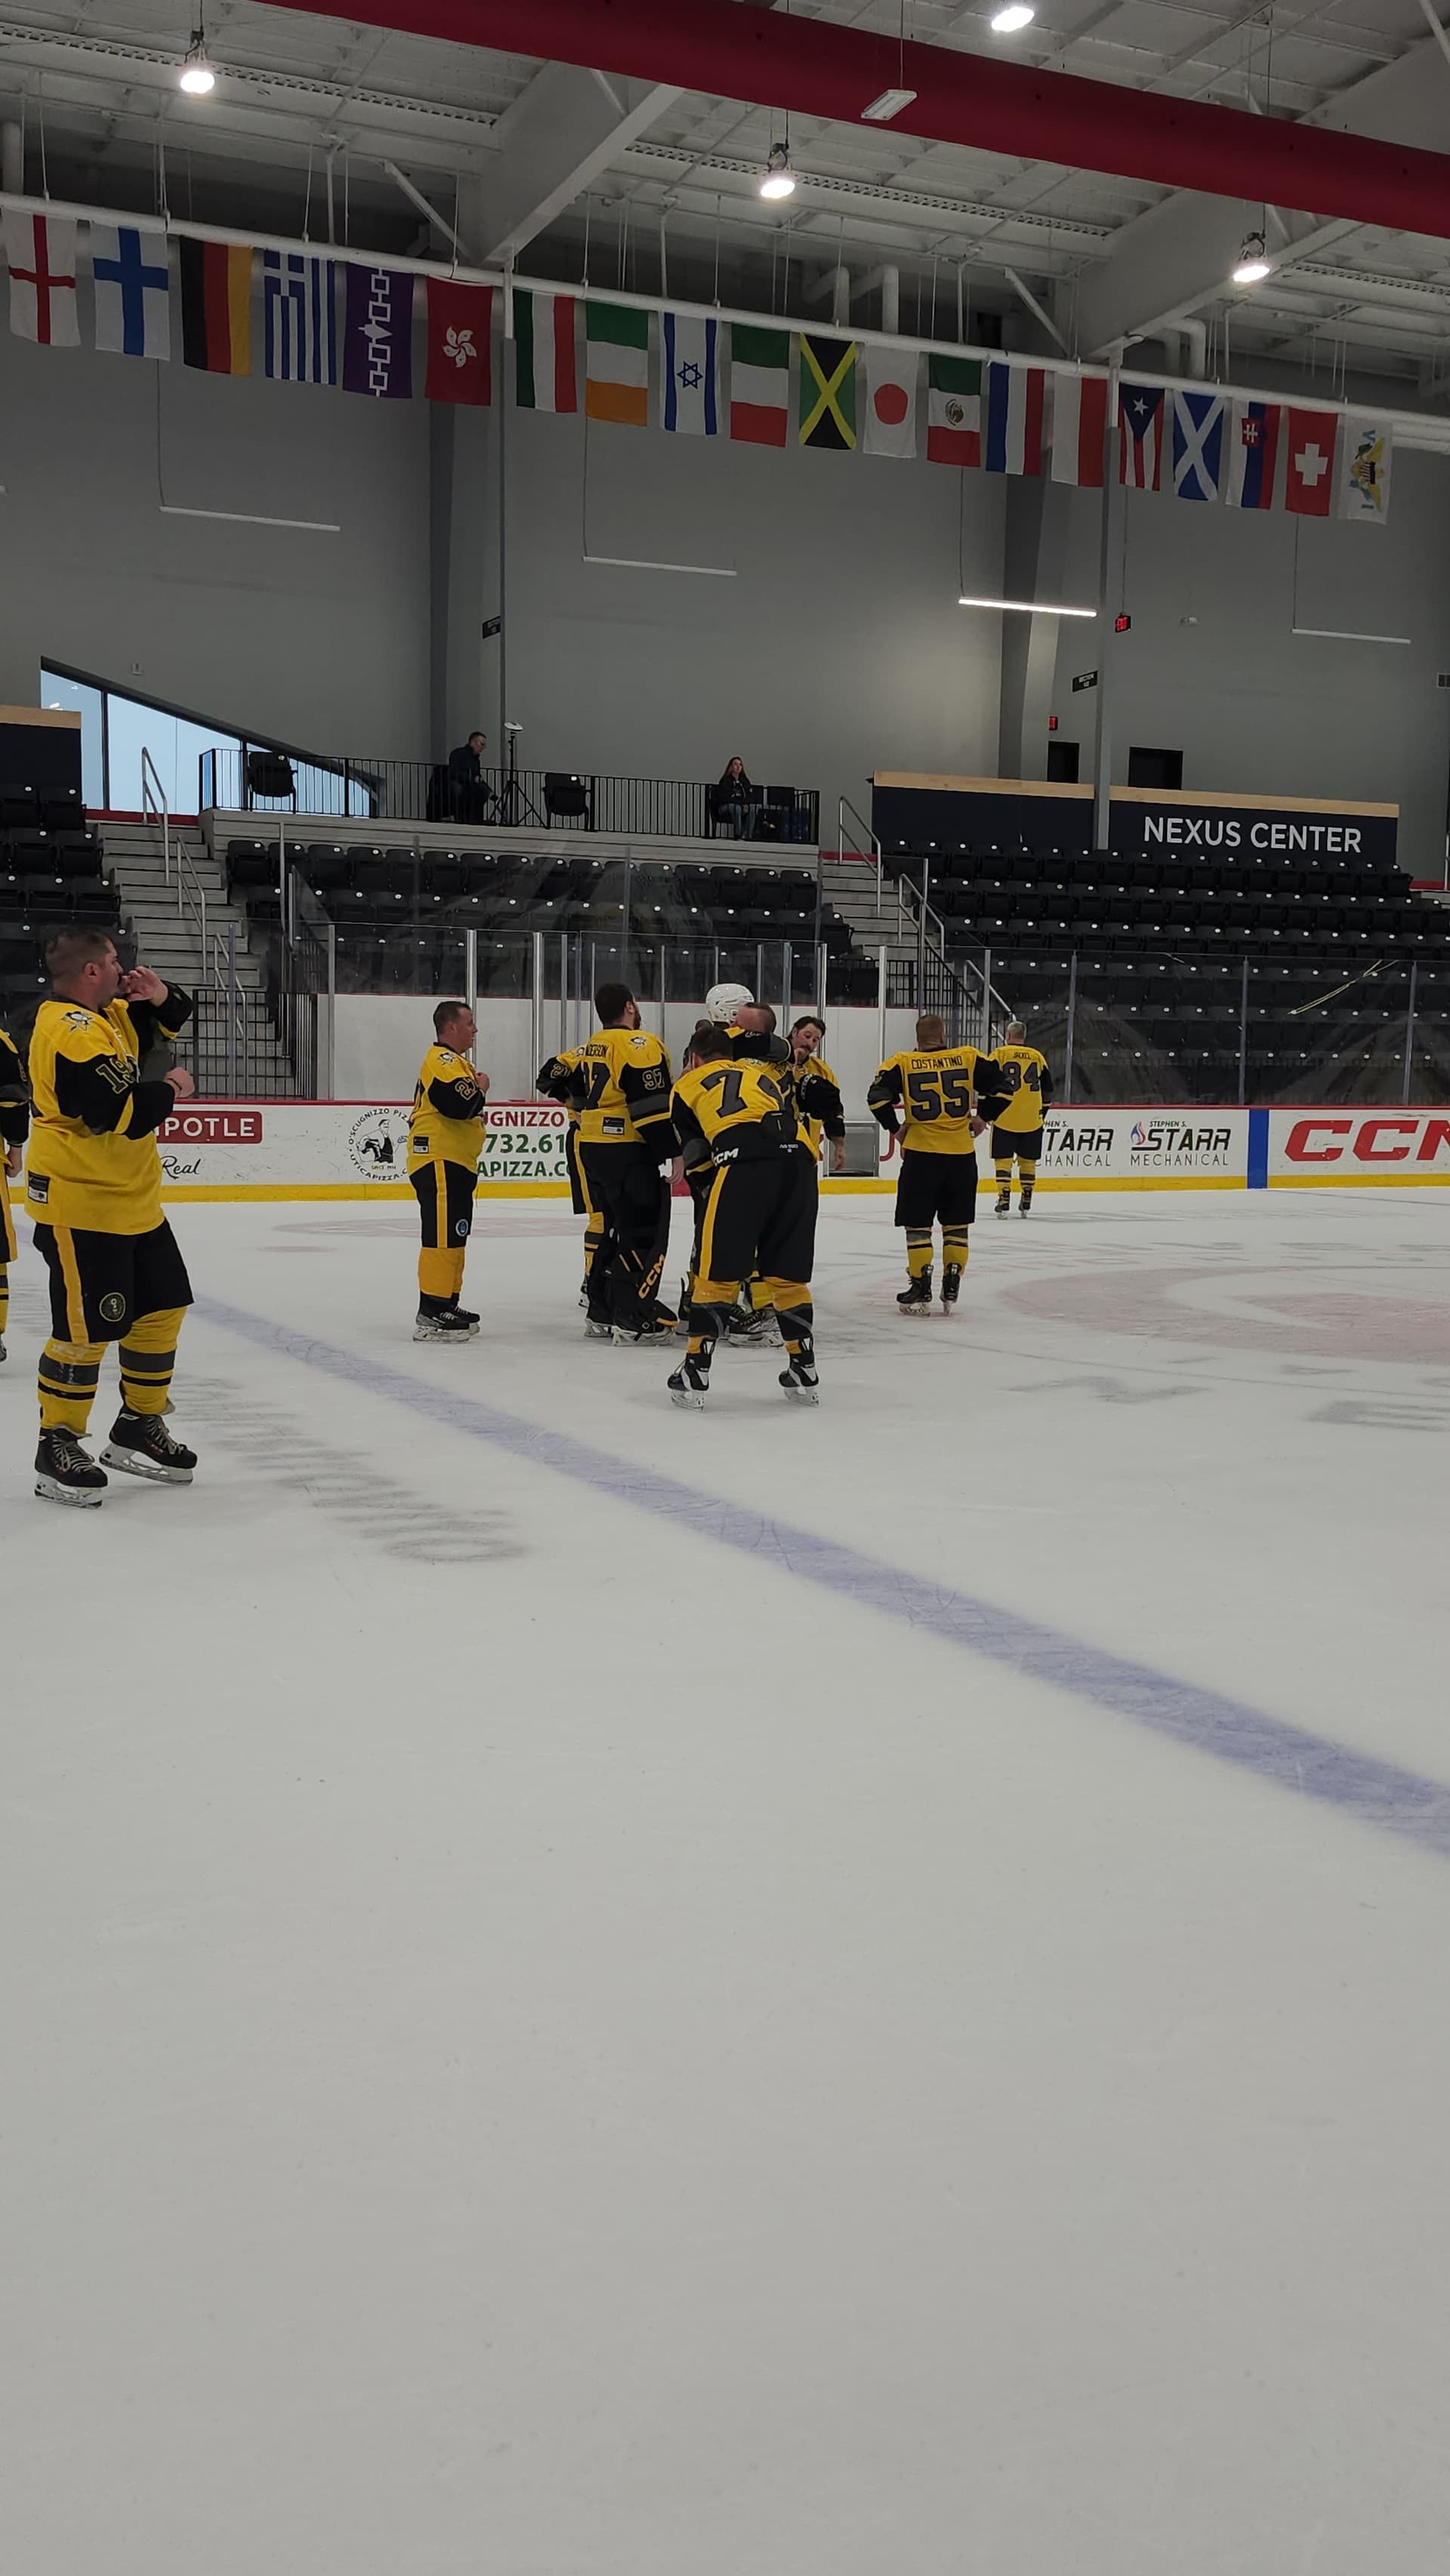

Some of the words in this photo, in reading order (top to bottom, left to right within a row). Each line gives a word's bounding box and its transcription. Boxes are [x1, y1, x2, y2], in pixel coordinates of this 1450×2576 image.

[1143, 816, 1242, 847] NEXUS
[1251, 822, 1362, 853] CENTER
[911, 1055, 964, 1070] COSTANTINO
[643, 1068, 665, 1091] 97
[1002, 1061, 1041, 1092] 84
[907, 1068, 970, 1122] 55
[1045, 1129, 1114, 1151] TARR
[1131, 1129, 1232, 1151] STARR
[160, 1155, 202, 1180] Real
[477, 1160, 569, 1177] APIZZA.C
[1130, 1154, 1229, 1166] MECHANICAL
[638, 1254, 665, 1299] CCM
